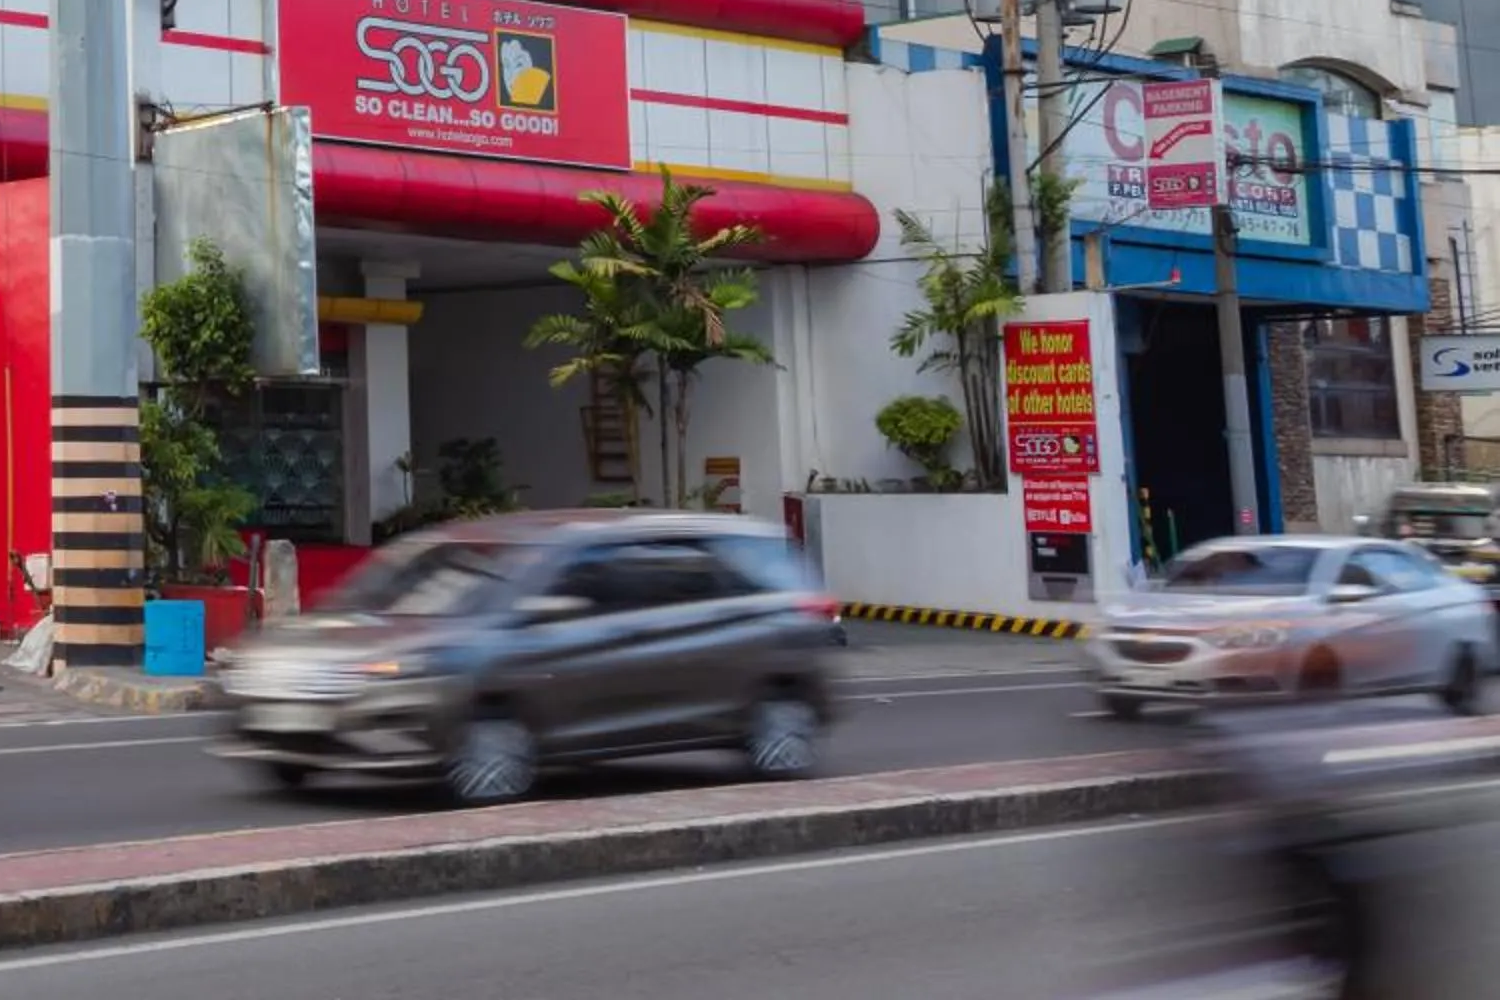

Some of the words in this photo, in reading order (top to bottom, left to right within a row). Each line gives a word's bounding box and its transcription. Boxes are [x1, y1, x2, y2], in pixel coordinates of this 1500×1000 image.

[357, 16, 490, 102] SOGO
[355, 94, 383, 116] SO
[501, 112, 559, 137] GOOD!
[1019, 329, 1039, 354] We
[1041, 328, 1074, 354] honor
[1007, 361, 1056, 385] discount
[1058, 357, 1092, 384] cards
[1009, 388, 1021, 414] of
[1023, 388, 1053, 414] other
[1056, 387, 1092, 414] hotels
